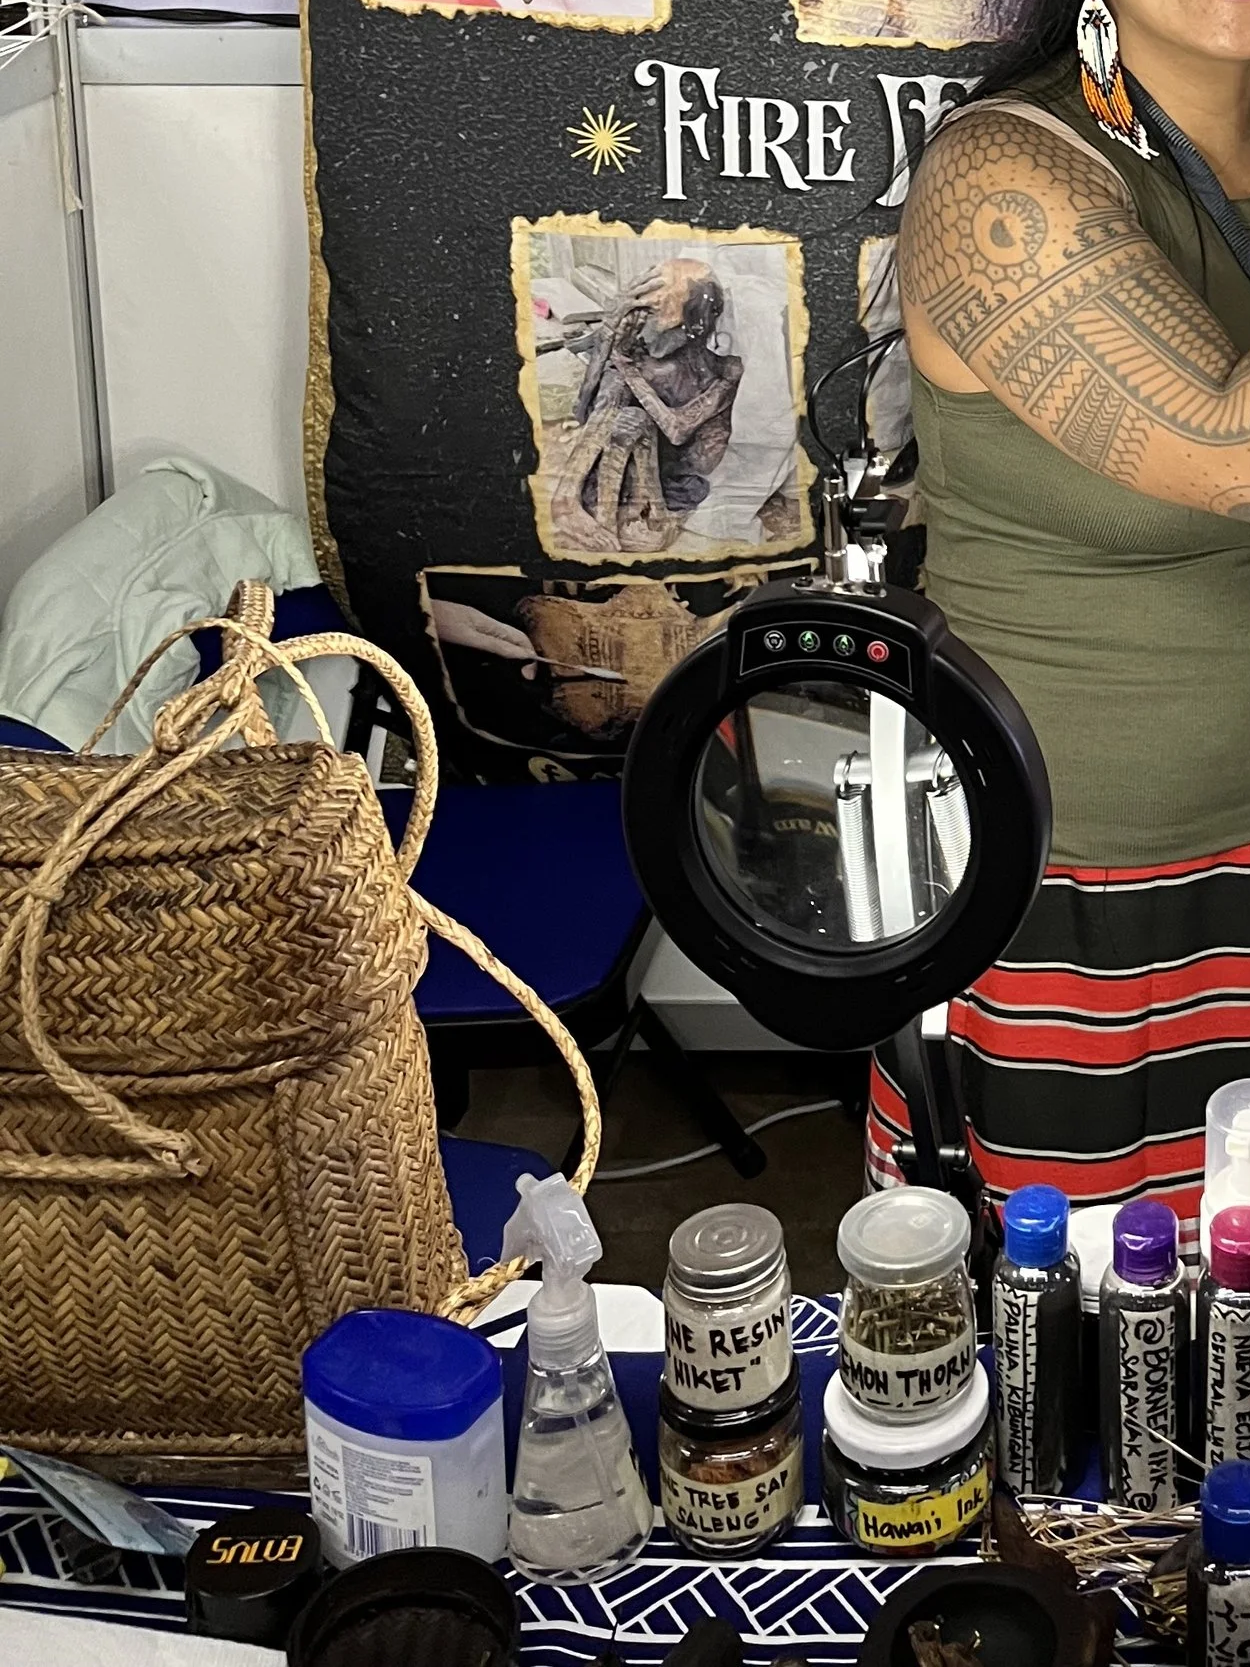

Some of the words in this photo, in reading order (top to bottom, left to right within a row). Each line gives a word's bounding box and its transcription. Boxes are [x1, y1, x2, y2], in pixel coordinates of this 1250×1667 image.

[634, 60, 857, 201] FIRE
[665, 1310, 696, 1357] INE
[709, 1306, 785, 1358] RESIN
[841, 1345, 888, 1395] EMON
[896, 1345, 971, 1398] THORN
[1210, 1331, 1227, 1411] CENTRAL
[1209, 1424, 1227, 1467] LUZ
[684, 1486, 740, 1510] TREE
[956, 1487, 984, 1523] Ink
